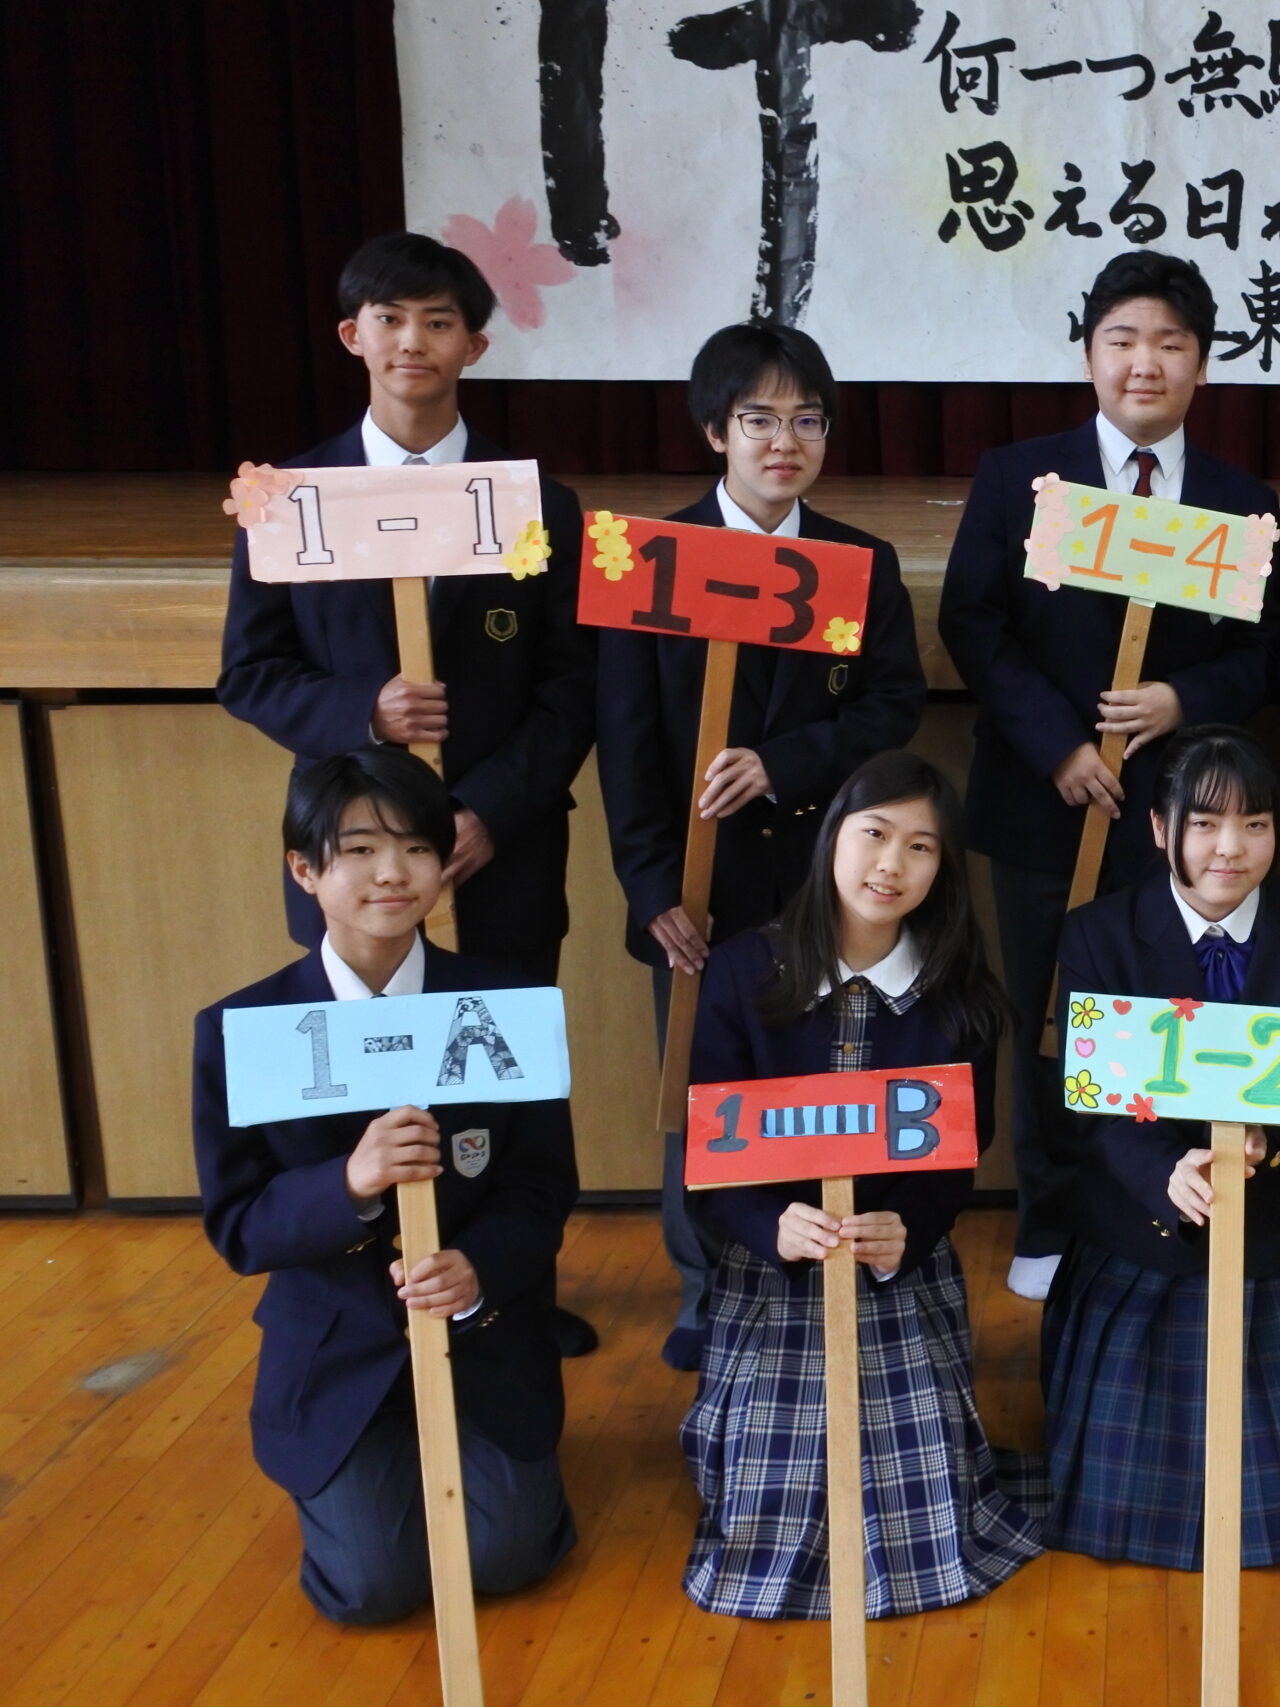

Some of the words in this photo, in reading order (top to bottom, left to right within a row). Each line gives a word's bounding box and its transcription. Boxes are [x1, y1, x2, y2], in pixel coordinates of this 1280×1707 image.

[630, 534, 820, 644] 1-3
[1069, 502, 1238, 600] 1-4
[294, 994, 525, 1101] 1-A
